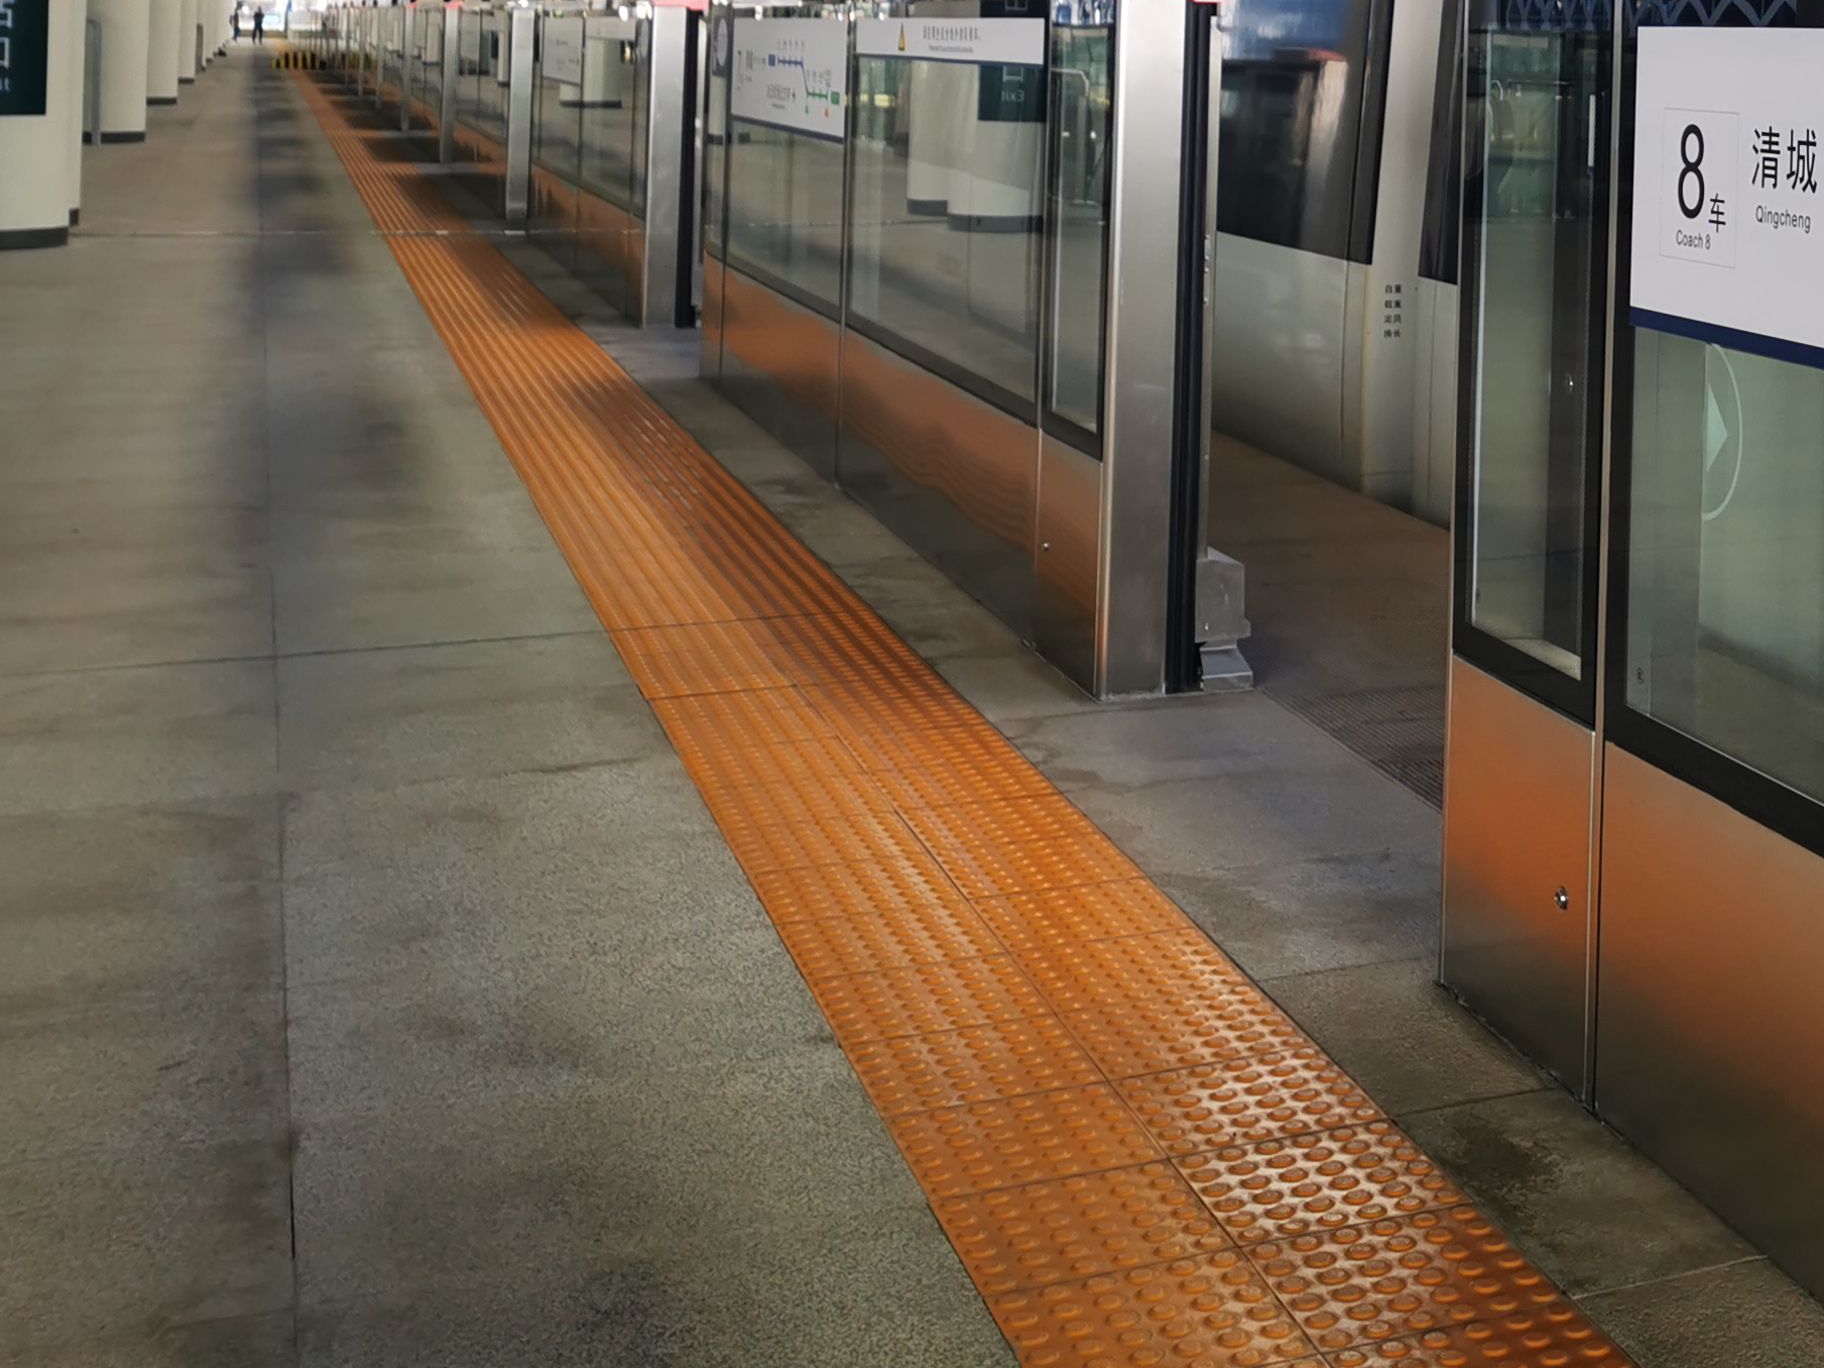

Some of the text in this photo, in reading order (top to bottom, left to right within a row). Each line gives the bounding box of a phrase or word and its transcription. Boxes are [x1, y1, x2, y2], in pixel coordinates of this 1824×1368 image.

[1752, 126, 1818, 194] 清城
[1755, 205, 1811, 234] Qingcheng
[1676, 229, 1711, 250] Coach 8
